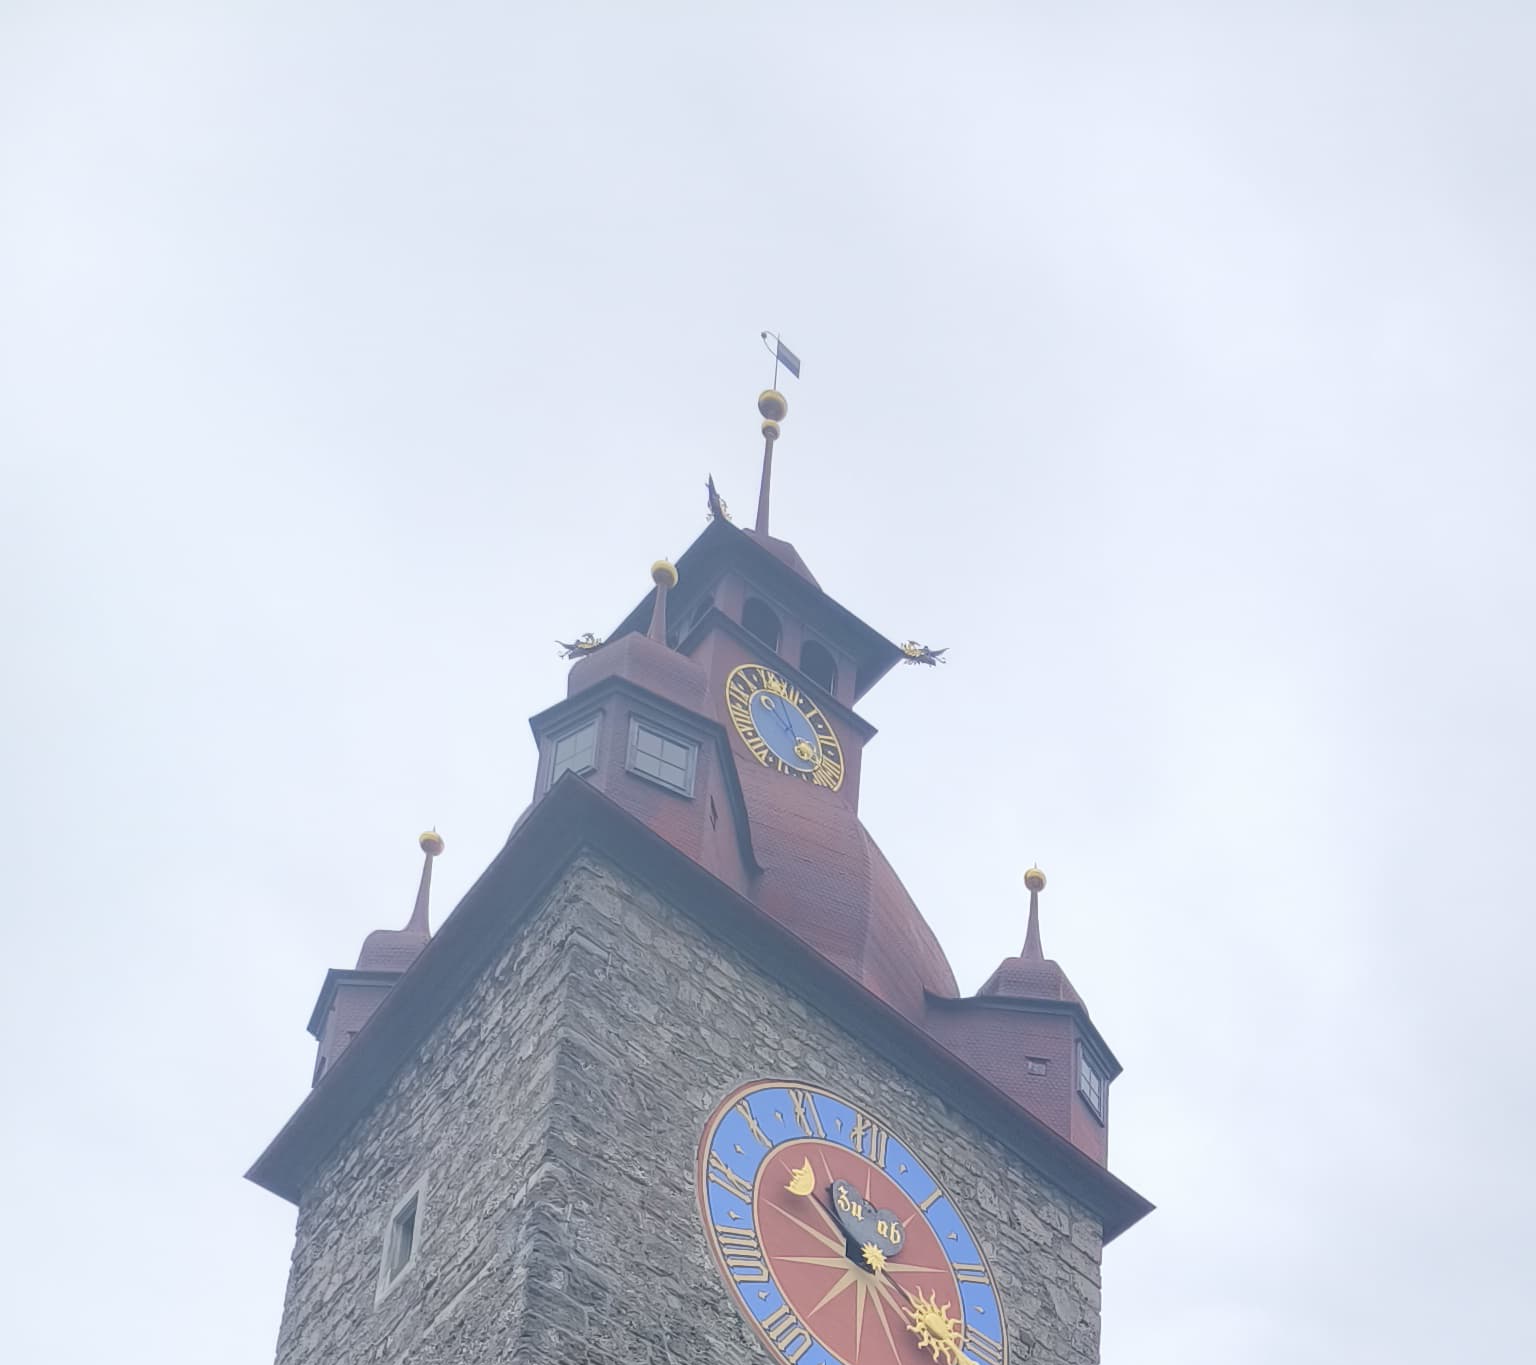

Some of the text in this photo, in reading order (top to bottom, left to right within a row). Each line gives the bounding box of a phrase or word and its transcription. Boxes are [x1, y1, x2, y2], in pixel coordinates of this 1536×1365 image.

[735, 1098, 774, 1149] X
[787, 1088, 827, 1138] XI
[851, 1112, 889, 1168] XII
[709, 1151, 753, 1204] IX
[877, 1219, 901, 1244] ab
[952, 1263, 991, 1285] II
